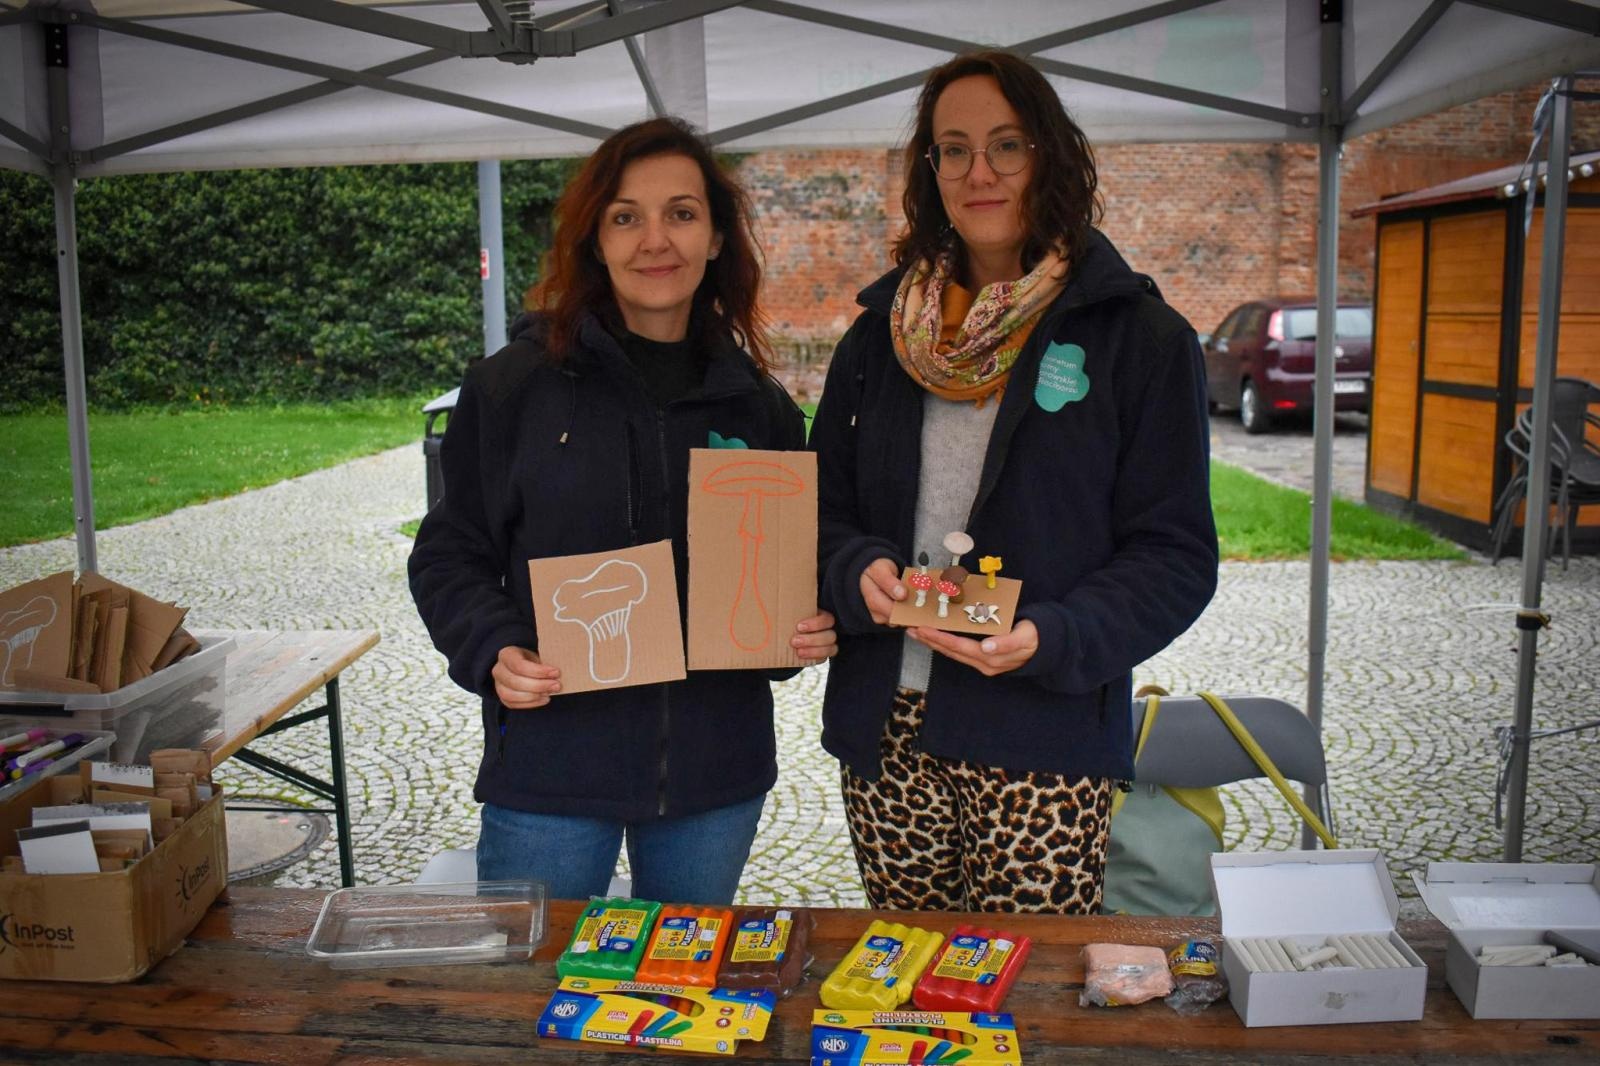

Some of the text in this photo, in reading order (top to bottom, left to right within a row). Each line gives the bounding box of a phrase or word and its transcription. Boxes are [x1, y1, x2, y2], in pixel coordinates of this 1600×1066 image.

[14, 922, 75, 942] InPost
[552, 1002, 579, 1017] ASTRA
[873, 1011, 942, 1019] PLASTELINA
[873, 1017, 945, 1025] PLASTICINE
[587, 1030, 683, 1047] PLASTICINE PLASTELINA
[821, 1038, 848, 1052] ASTRA
